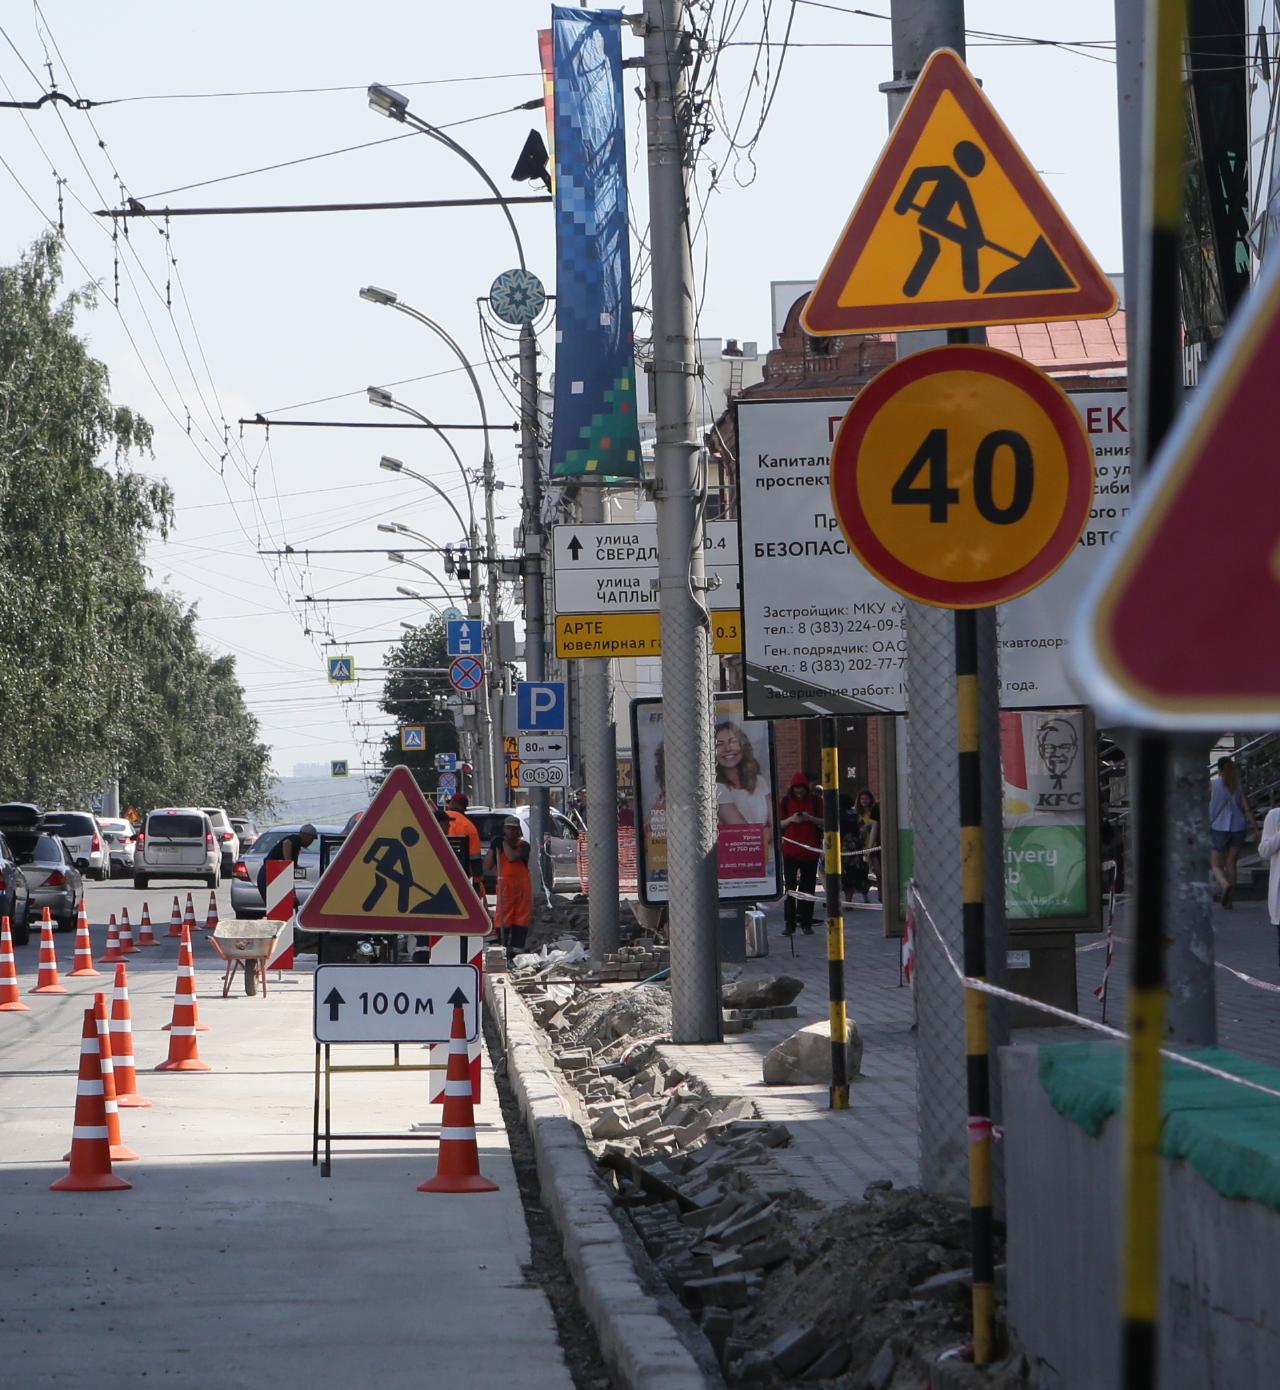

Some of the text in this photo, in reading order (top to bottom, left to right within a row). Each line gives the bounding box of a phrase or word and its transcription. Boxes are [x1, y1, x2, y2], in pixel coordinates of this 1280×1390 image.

[891, 428, 1035, 525] 40
[596, 535, 639, 547] улица
[597, 579, 640, 590] улица
[764, 605, 849, 618] Застройщик:
[854, 603, 886, 615] МКУ
[563, 622, 737, 638] АРТЕ 0.3
[764, 624, 794, 635] тел.:
[798, 622, 806, 633] 8
[810, 621, 844, 635] (383)
[563, 639, 646, 651] ювелирная
[764, 645, 790, 656] Ген.
[793, 644, 868, 657] подрядчик:
[800, 661, 808, 672] 8
[811, 660, 845, 674] (383)
[765, 686, 848, 699] Завершение
[852, 684, 895, 696] работ:
[1006, 681, 1038, 691] года.
[530, 687, 557, 725] P
[536, 771, 546, 779] 15
[550, 770, 560, 780] 20
[1036, 792, 1081, 806] KFC
[1004, 847, 1057, 867] ivery
